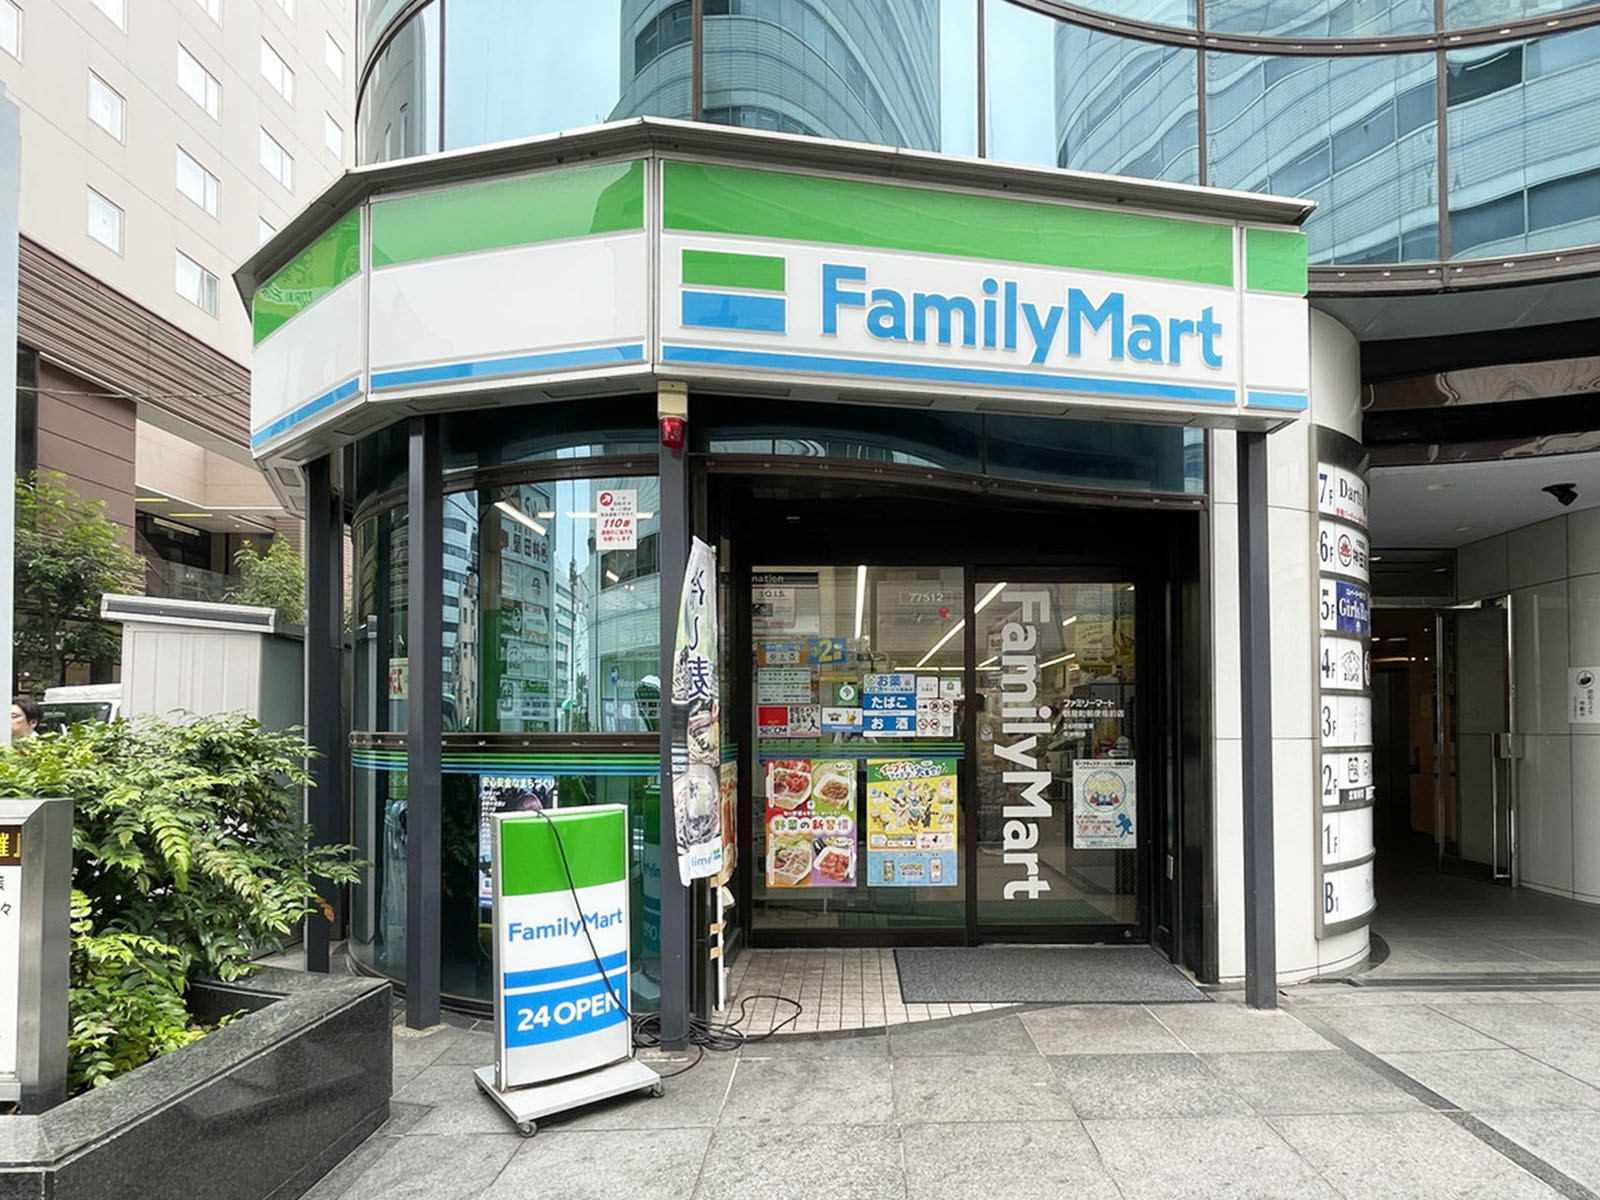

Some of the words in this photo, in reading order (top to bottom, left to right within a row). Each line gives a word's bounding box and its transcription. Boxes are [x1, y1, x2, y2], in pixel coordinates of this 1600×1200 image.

[821, 263, 1223, 369] FamilyMart
[1319, 473, 1334, 505] 7F
[1320, 531, 1334, 563] 6F
[1321, 589, 1335, 620] 5F
[1322, 649, 1336, 679] 4F
[877, 675, 902, 688] お薬
[871, 696, 908, 709] たばこ
[1063, 699, 1115, 708] ファミリーマート
[1322, 706, 1337, 737] 3F
[993, 590, 1053, 900] FamilyMart
[1323, 765, 1338, 795] 2F
[1323, 823, 1338, 855] 1F
[1324, 882, 1339, 913] B1
[508, 907, 623, 942] FamilyMart
[517, 1006, 550, 1032] 24
[553, 988, 621, 1024] OPEN
